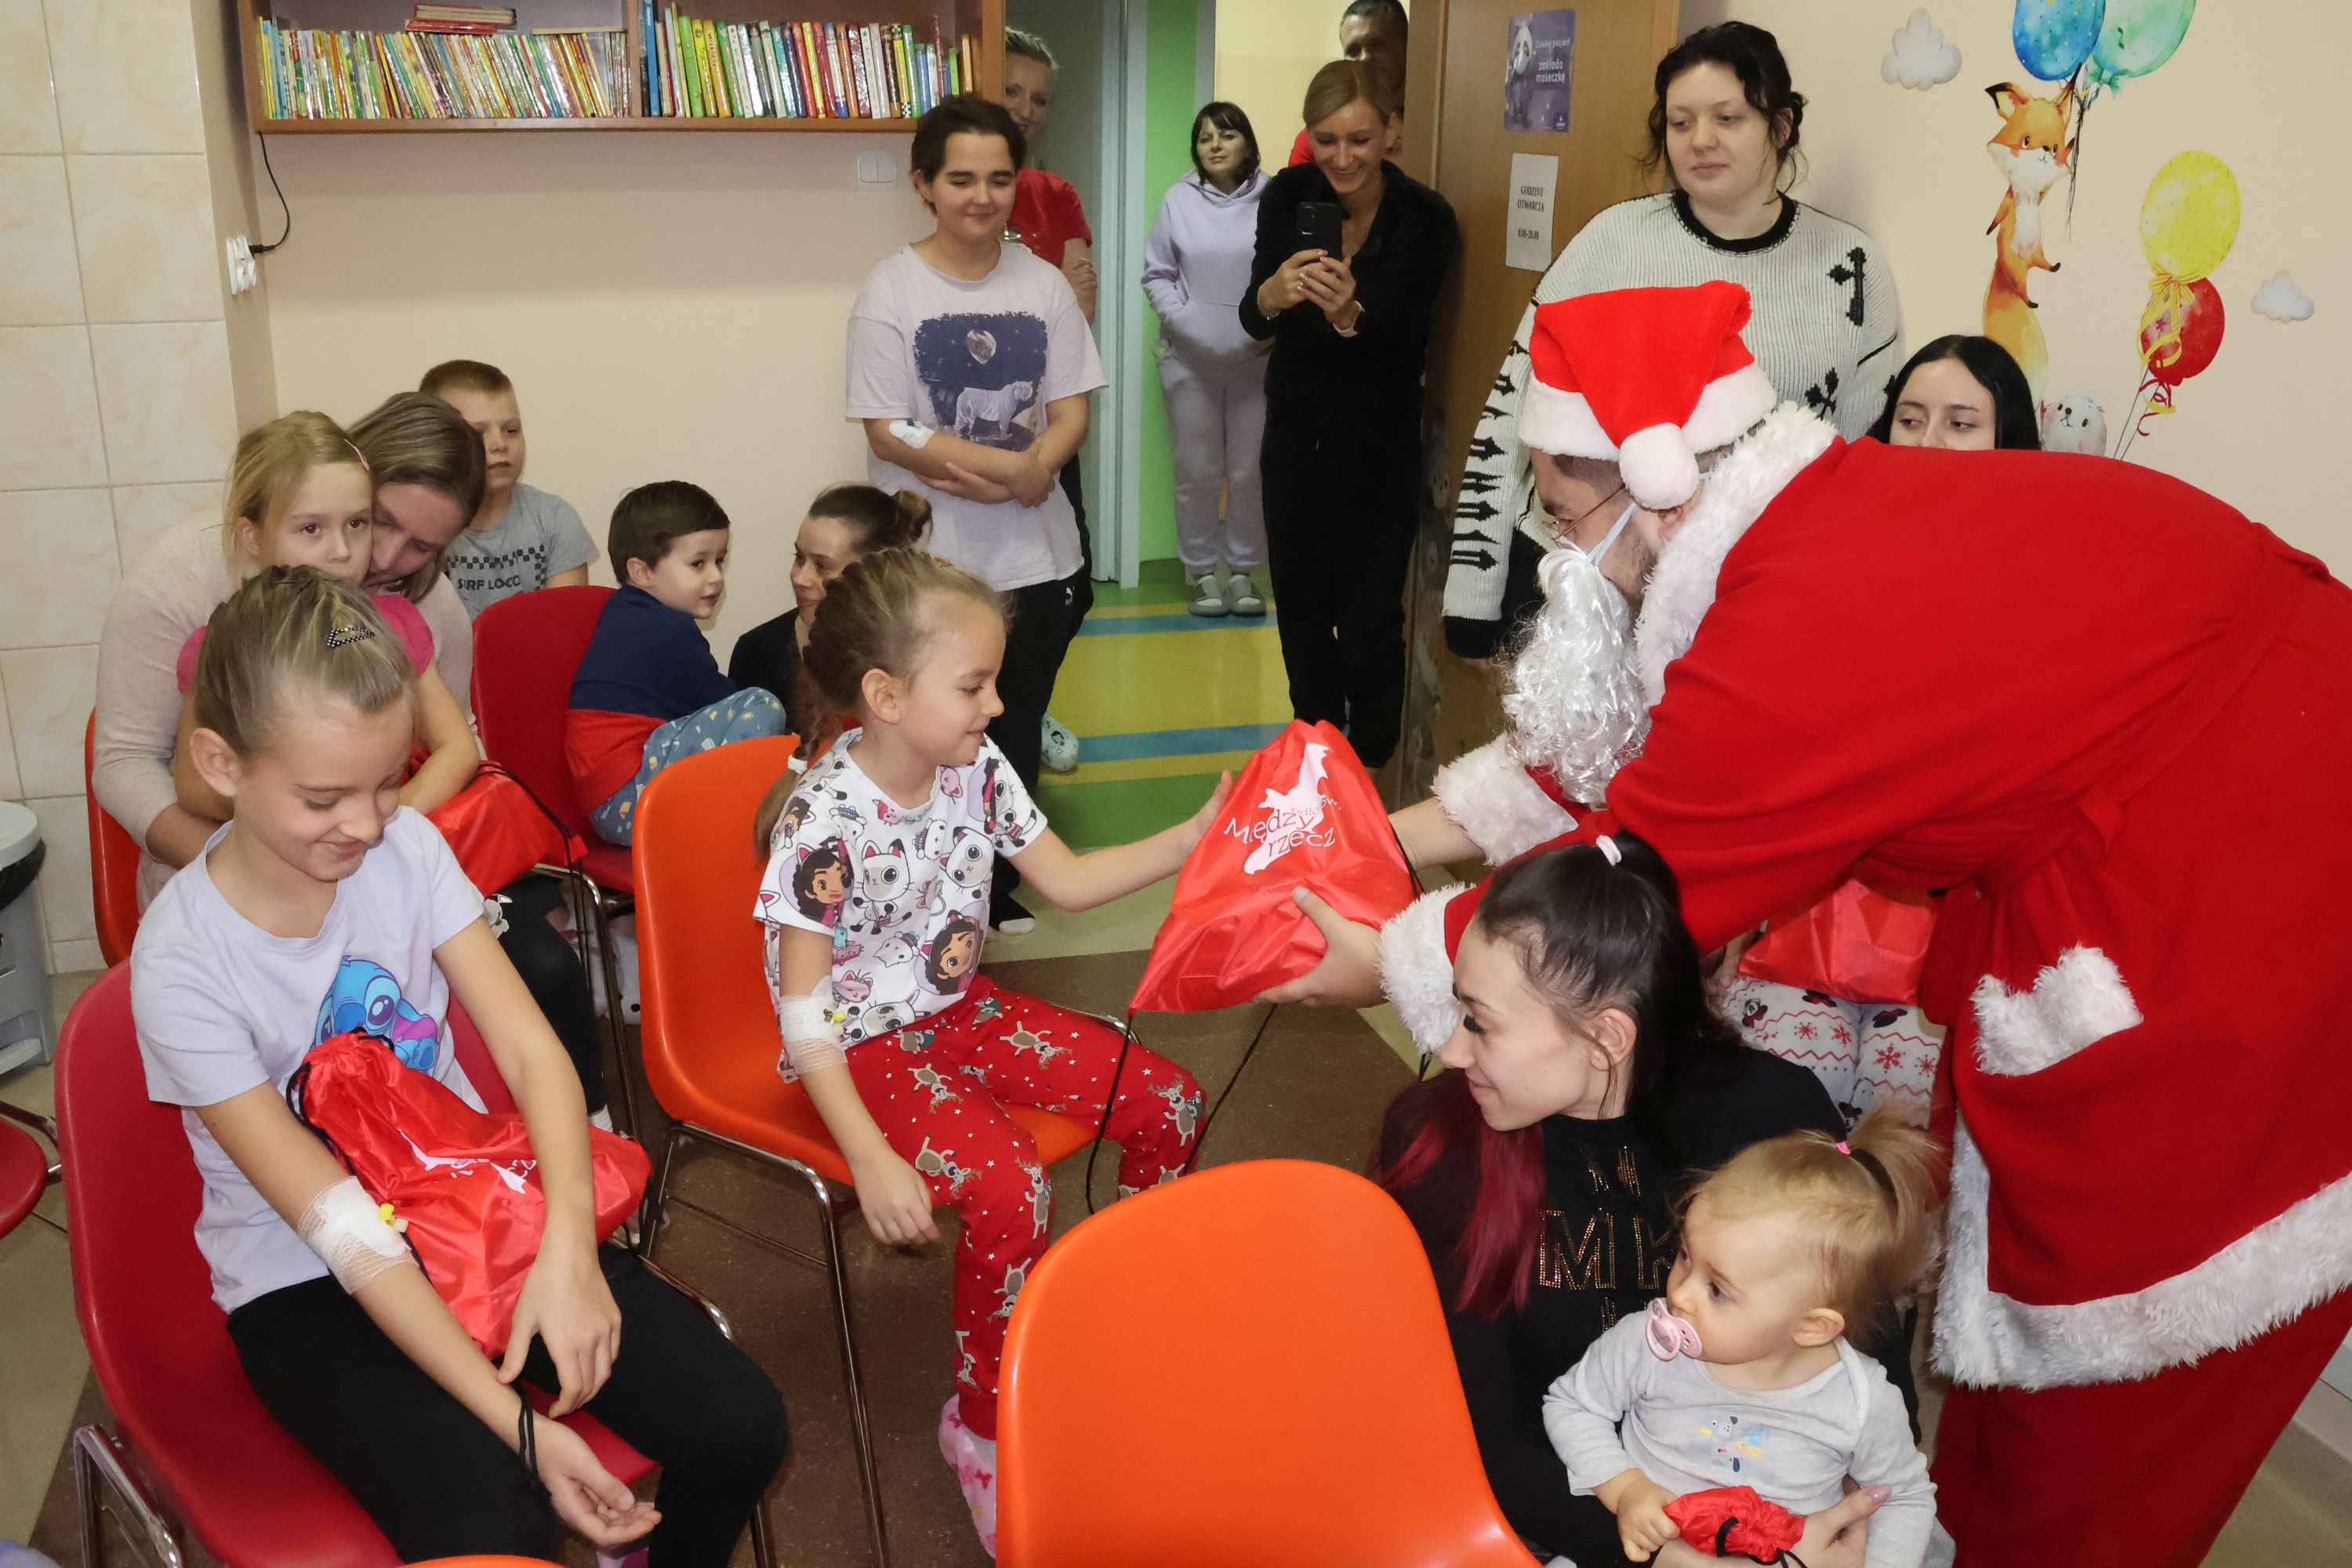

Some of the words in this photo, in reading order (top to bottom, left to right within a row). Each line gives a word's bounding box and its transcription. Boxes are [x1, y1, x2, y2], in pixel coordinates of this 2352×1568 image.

[1520, 185, 1544, 197] GODZINY
[1517, 199, 1544, 212] OTWARCIA
[457, 579, 485, 590] SURF
[488, 575, 521, 590] LOCO
